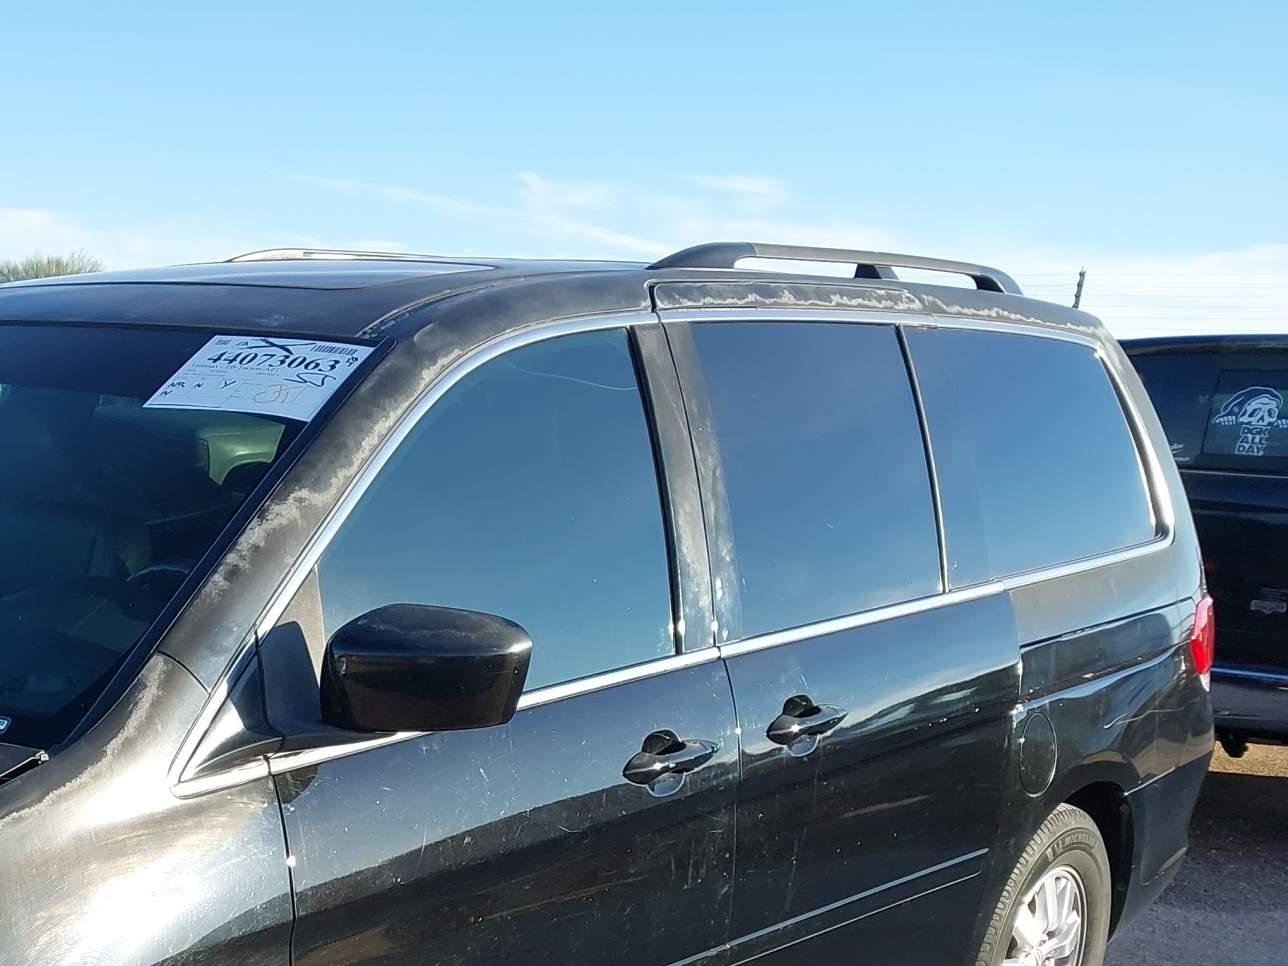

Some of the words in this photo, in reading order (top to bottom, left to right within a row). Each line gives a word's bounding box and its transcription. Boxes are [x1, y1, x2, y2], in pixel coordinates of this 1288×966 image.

[208, 351, 340, 373] 44073063
[1239, 436, 1265, 446] ALL
[1236, 445, 1264, 455] DAY
